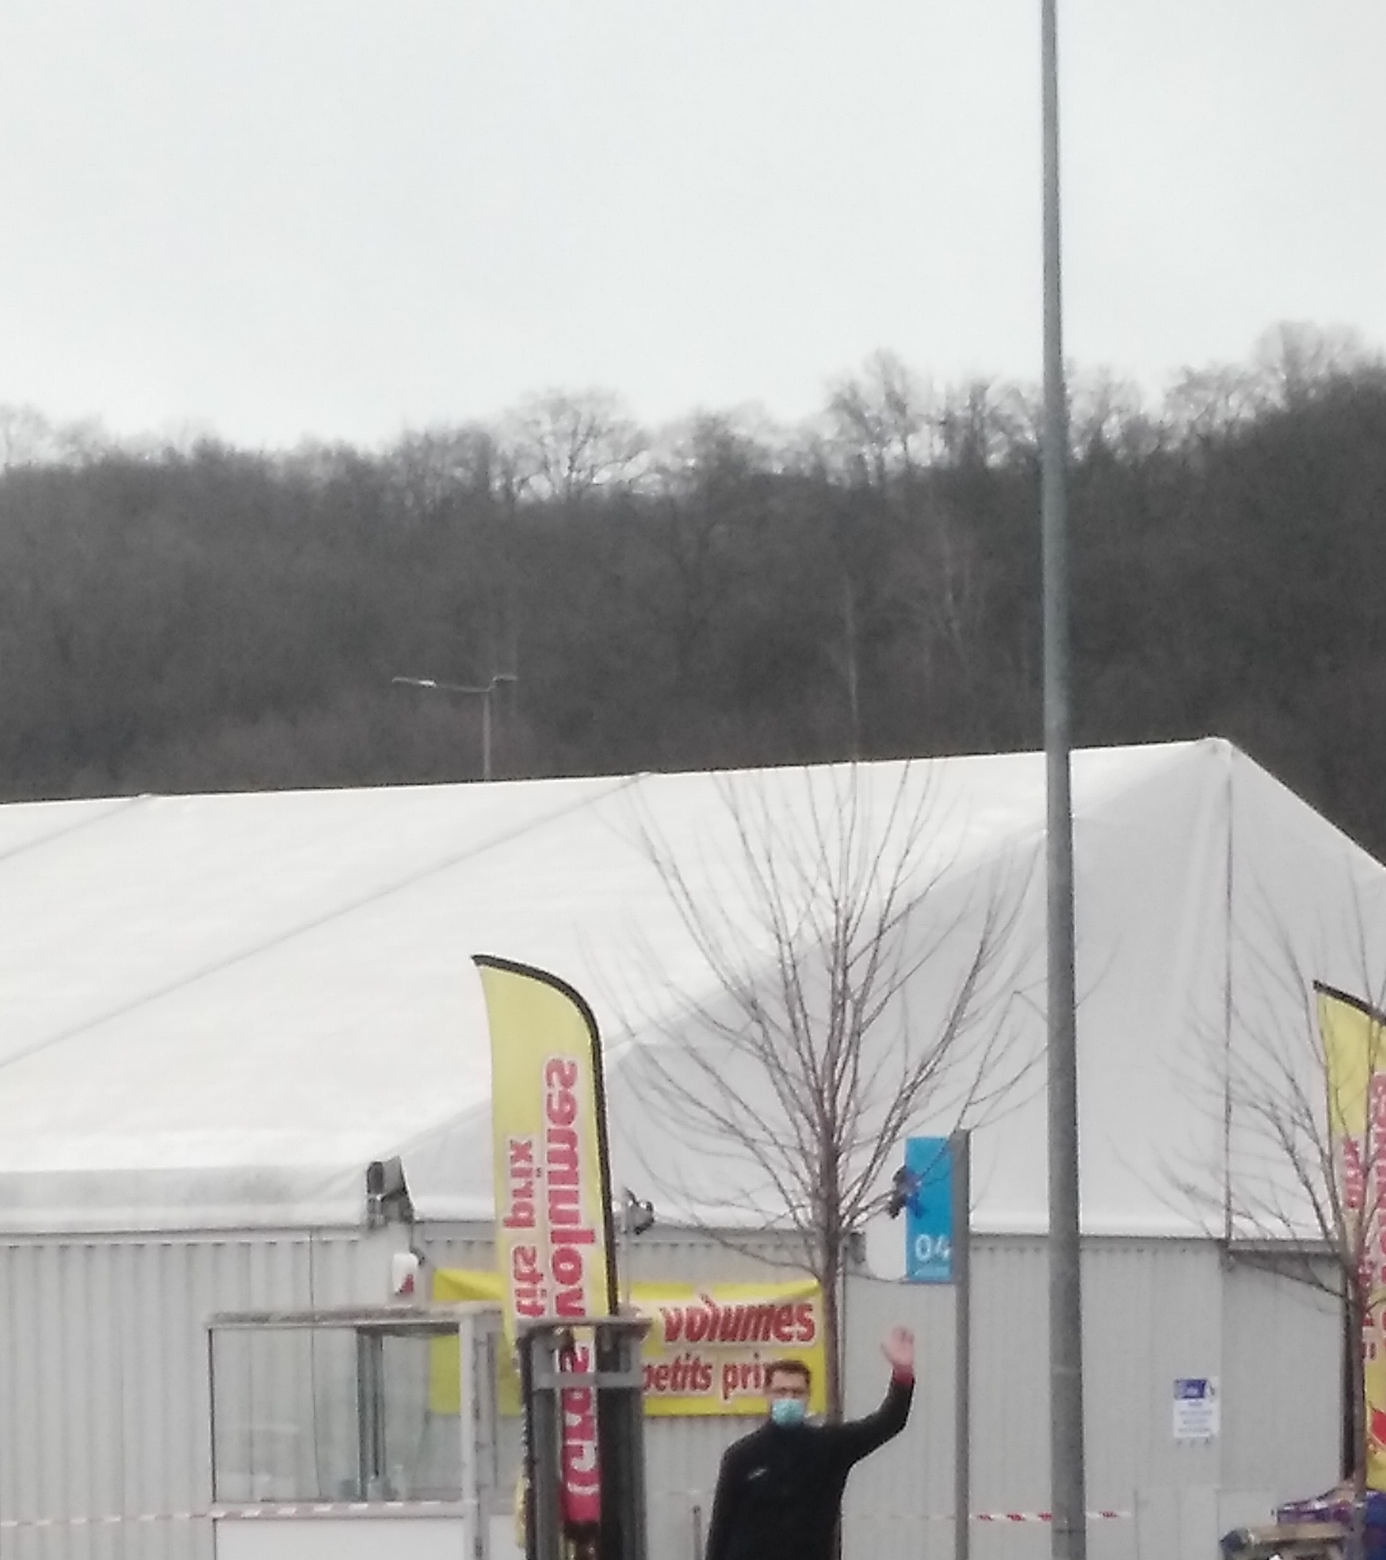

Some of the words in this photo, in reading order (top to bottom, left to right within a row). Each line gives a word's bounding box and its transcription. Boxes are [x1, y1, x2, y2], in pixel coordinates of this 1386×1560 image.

[915, 1233, 951, 1262] 04
[660, 1293, 816, 1342] volumes
[723, 1352, 771, 1401] pri
